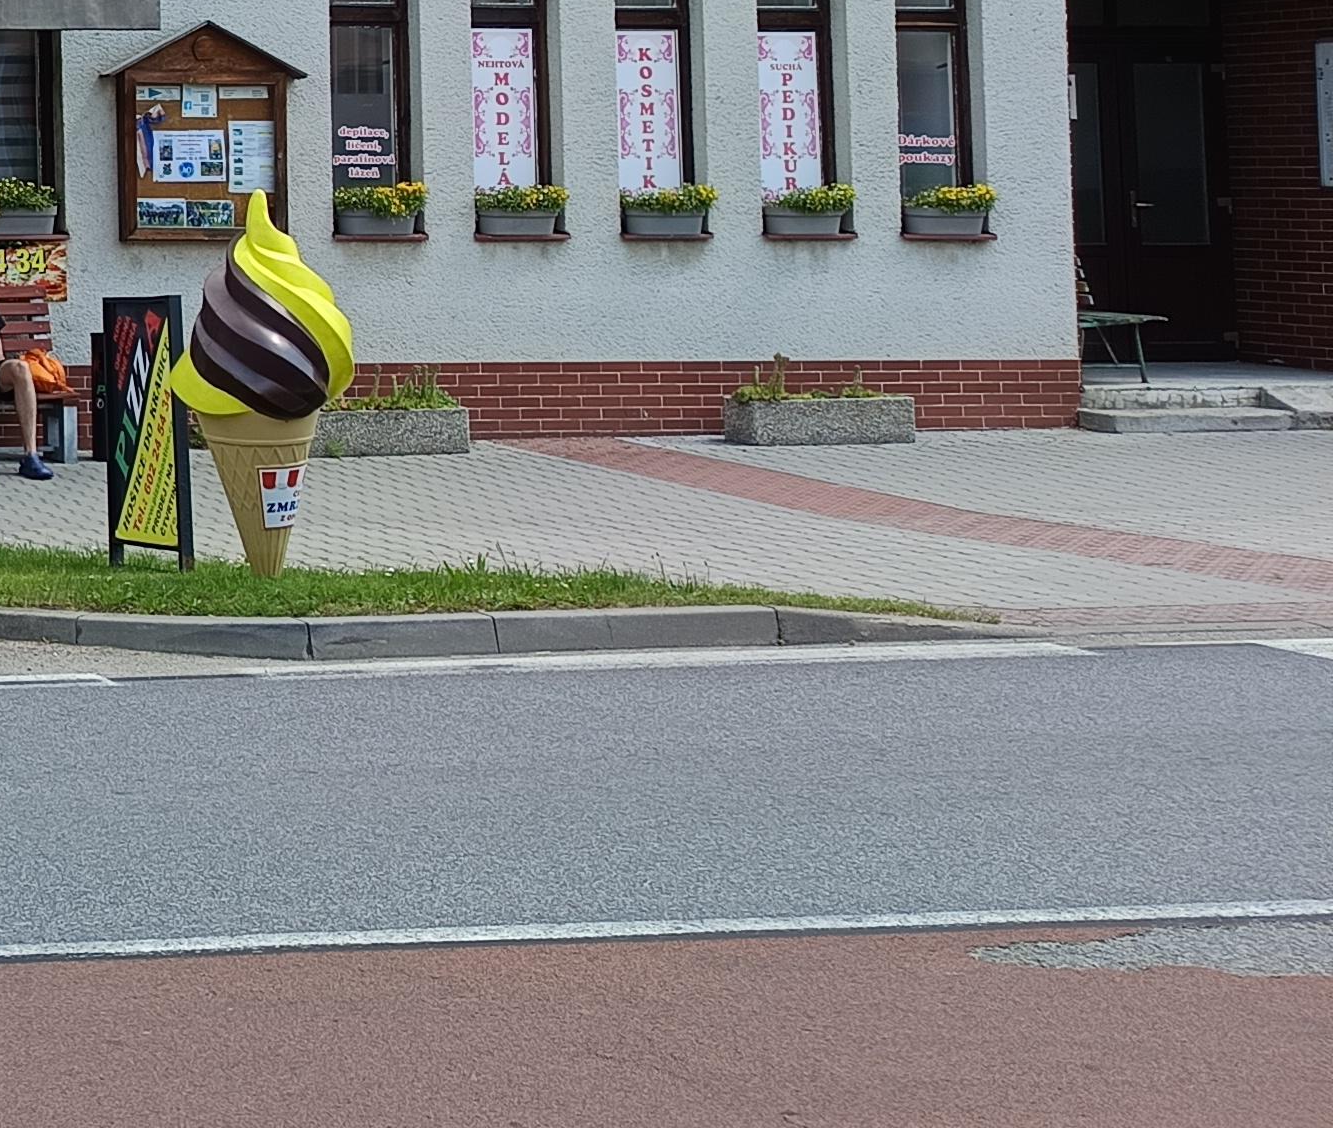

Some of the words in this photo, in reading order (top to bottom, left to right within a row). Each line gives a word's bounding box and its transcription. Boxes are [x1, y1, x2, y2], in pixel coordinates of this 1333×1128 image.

[478, 60, 525, 69] NEHTOVÁ
[769, 62, 803, 71] SUCHÁ
[494, 72, 512, 186] MODELÁ
[638, 48, 657, 189] KOSMETIK
[338, 126, 389, 139] depilace,
[780, 72, 798, 191] PEDIKÚR
[898, 135, 955, 147] Dárkové
[333, 153, 395, 166] parafinová
[898, 152, 955, 165] poukazy
[348, 167, 380, 178] lázeň
[16, 248, 47, 274] 34
[115, 309, 163, 481] PIZZA
[161, 389, 171, 412] 34
[144, 422, 153, 452] DO
[157, 414, 167, 437] 54
[152, 438, 162, 462] 24
[144, 462, 157, 496] 602
[152, 487, 168, 534] PRODEJ
[167, 463, 174, 480] NA
[133, 498, 148, 532] Tel.:
